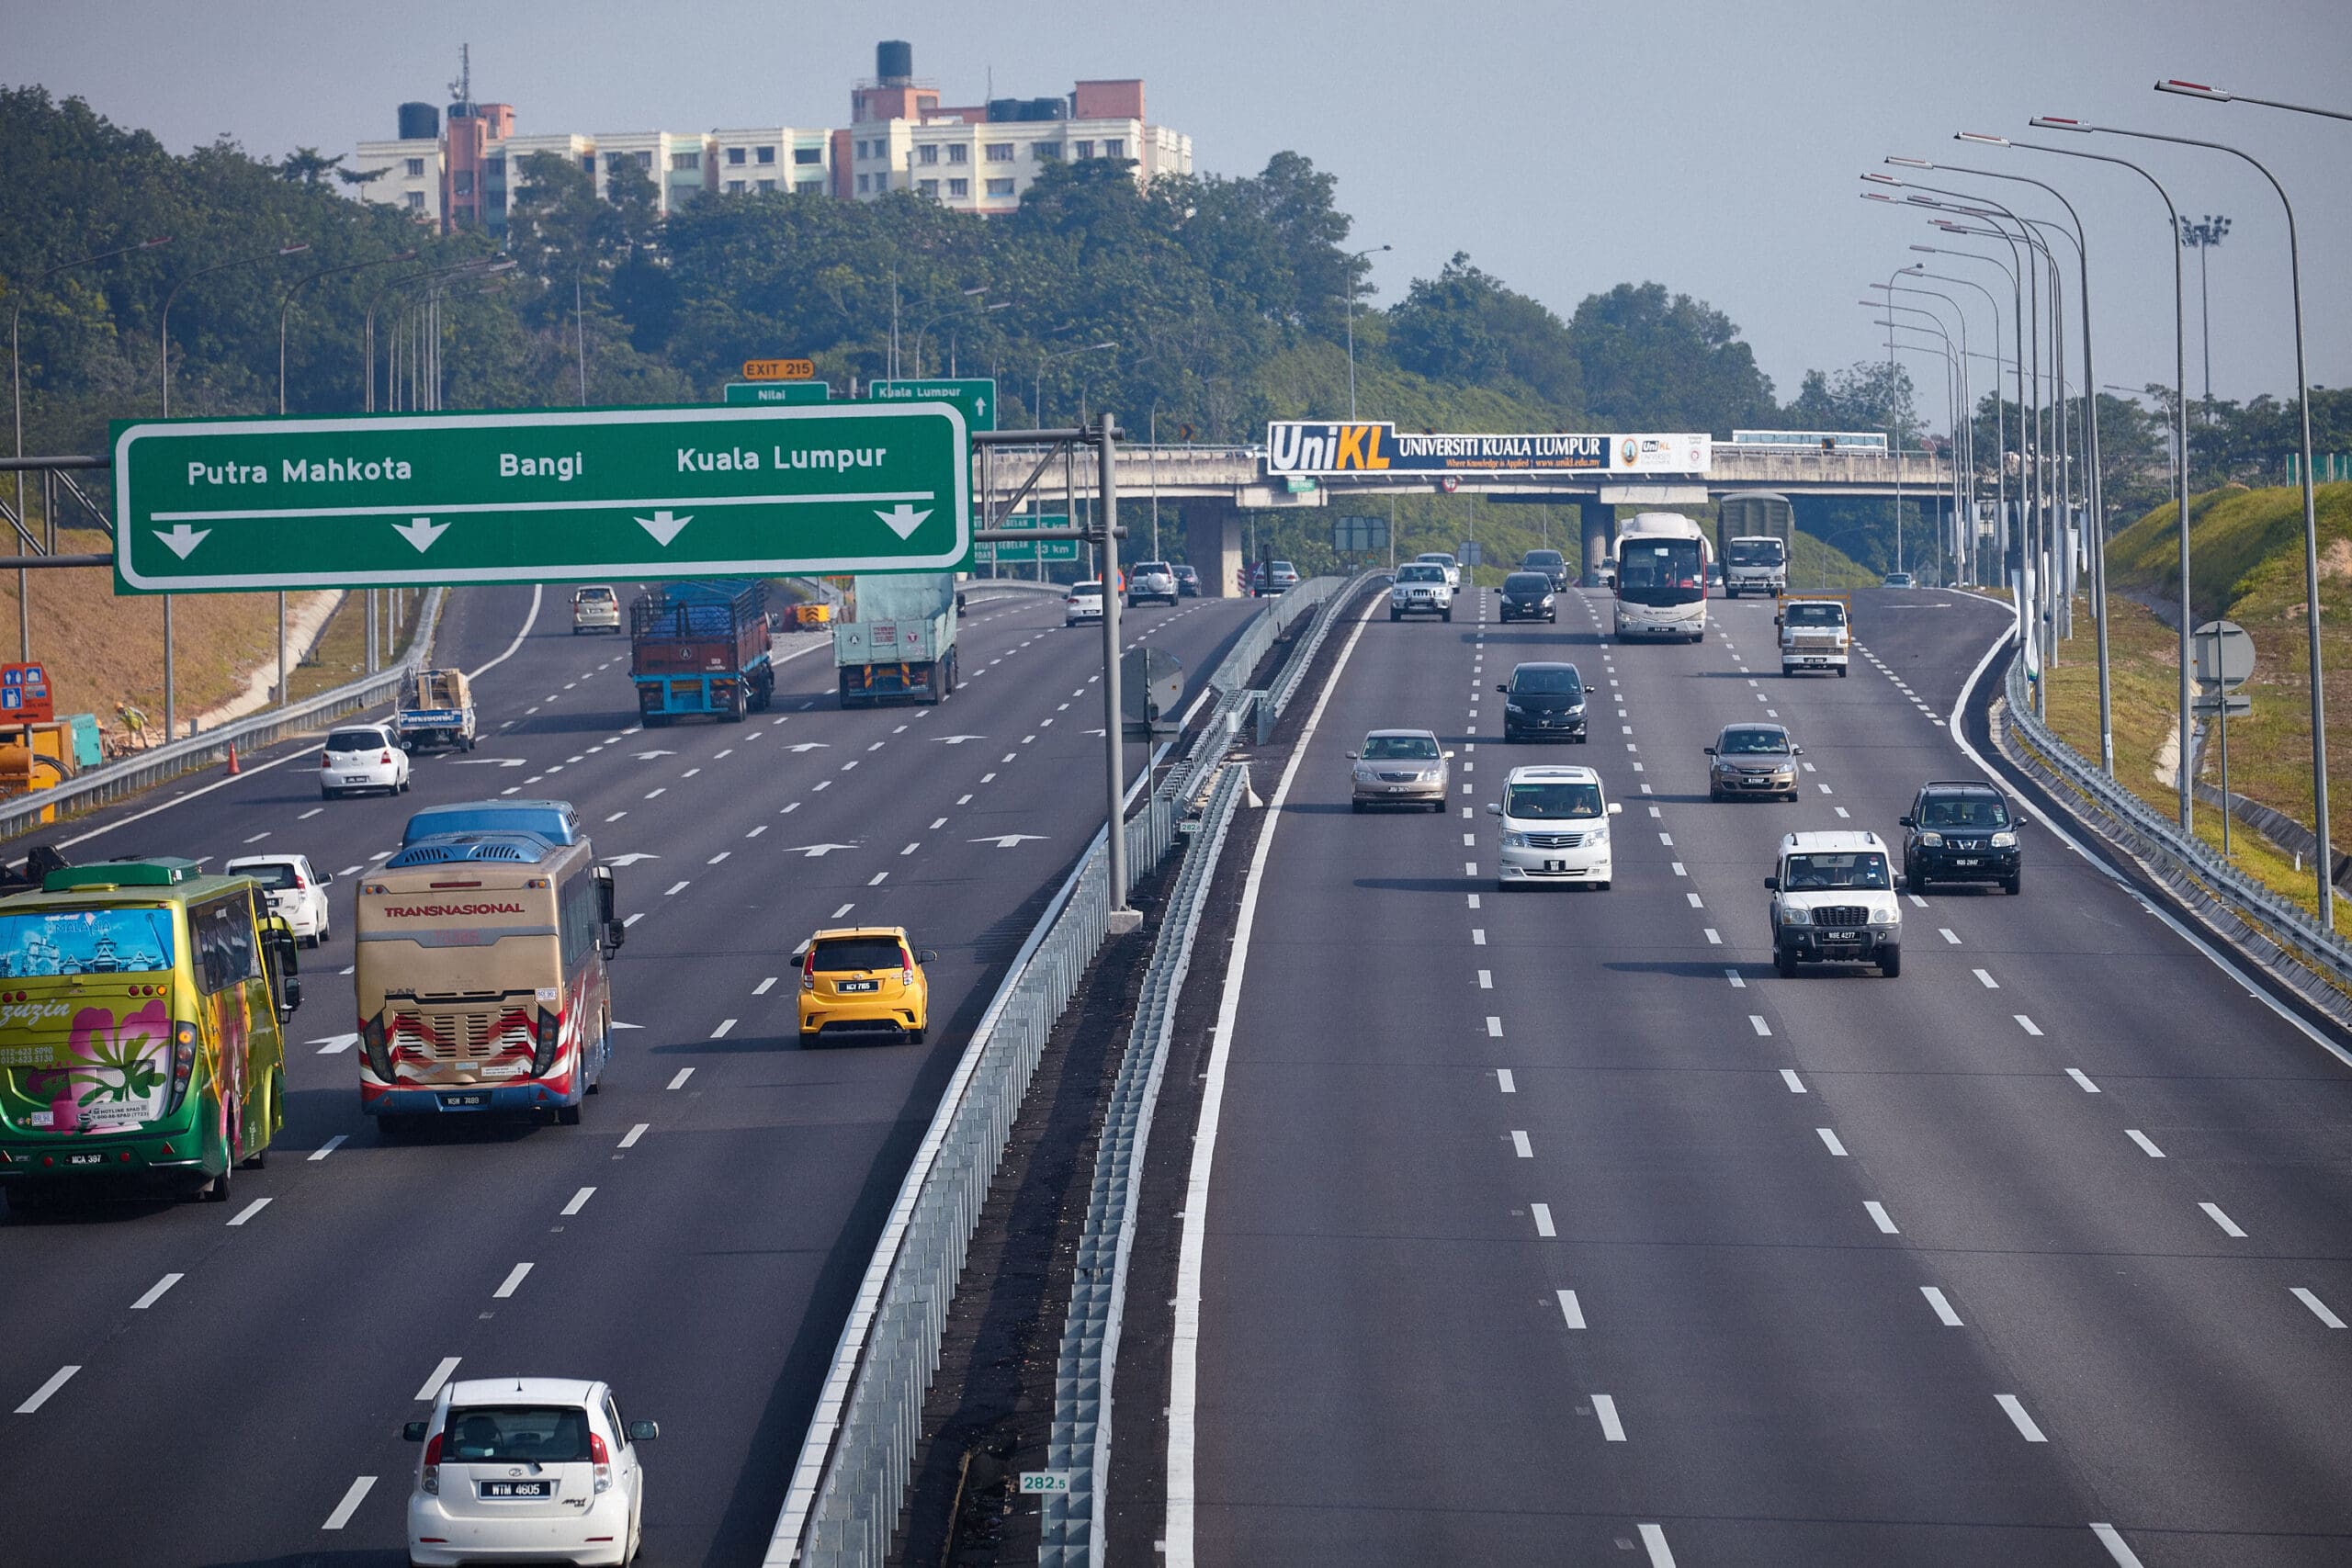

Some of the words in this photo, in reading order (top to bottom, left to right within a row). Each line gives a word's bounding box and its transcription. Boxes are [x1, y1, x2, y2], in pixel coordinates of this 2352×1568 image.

[746, 364, 778, 376] EXIT
[786, 363, 810, 375] 215
[758, 389, 786, 400] Nilai
[879, 387, 912, 399] Kuala
[917, 387, 961, 398] Lumpur
[1272, 425, 1391, 470] UniKL
[1399, 438, 1478, 457] UNIVERSITI
[1482, 438, 1532, 456] KUALA
[1535, 437, 1600, 456] LUMPUR
[500, 451, 582, 481] Bangi
[678, 446, 760, 472] Kuala
[774, 446, 887, 474] Lumpur
[188, 460, 268, 486] Putra
[282, 457, 412, 483] Mahkota
[1053, 545, 1069, 554] km
[401, 713, 454, 724] Panasonic
[384, 904, 525, 918] TRANSNASIONAL
[1, 1048, 32, 1056] 012-623
[1, 1055, 32, 1064] 012-623
[35, 1055, 53, 1063] 5130
[492, 1481, 512, 1495] WTM
[515, 1481, 540, 1495] 4605
[1024, 1476, 1066, 1489] 282.5
